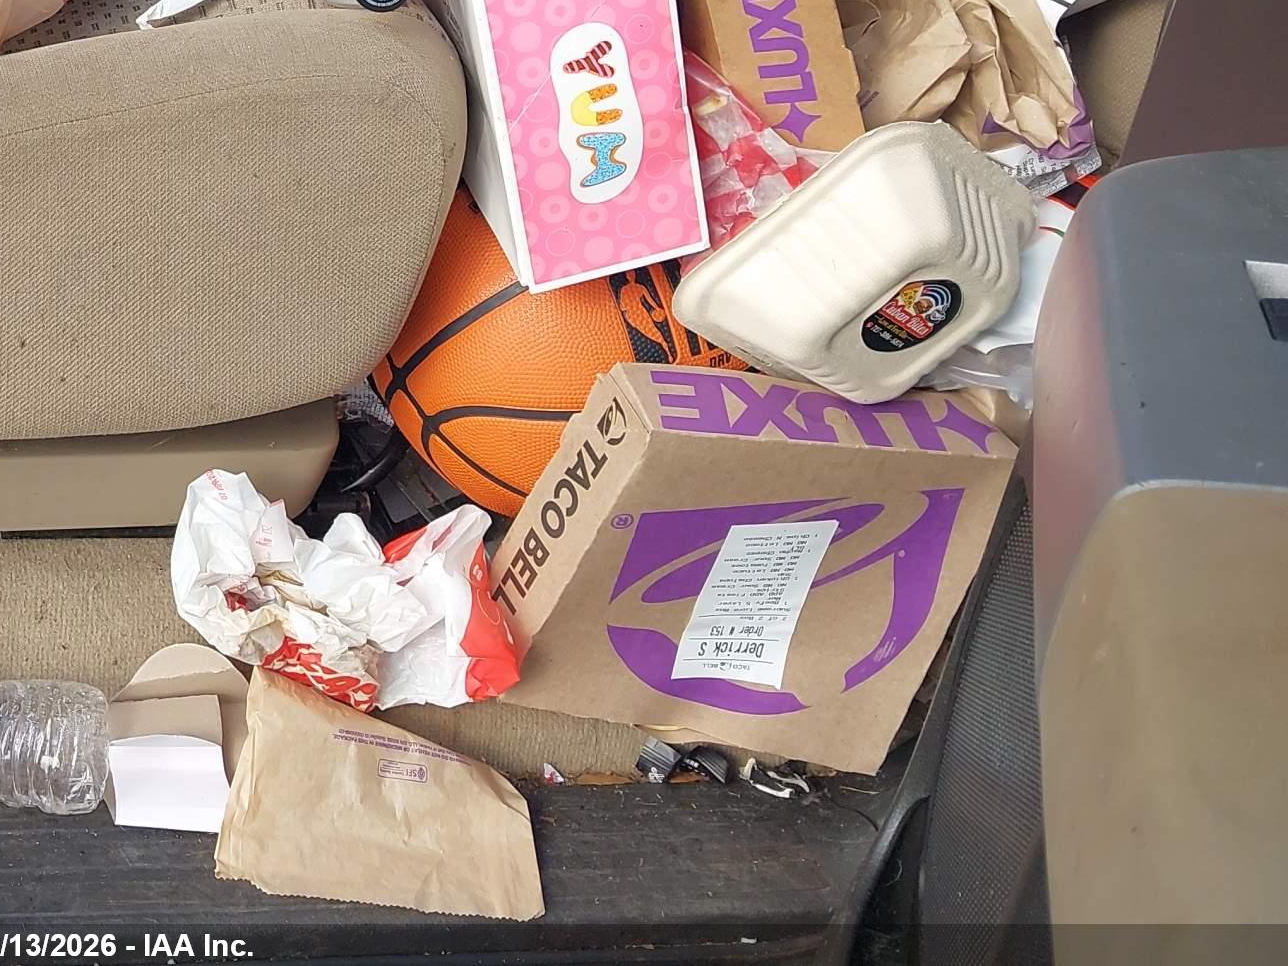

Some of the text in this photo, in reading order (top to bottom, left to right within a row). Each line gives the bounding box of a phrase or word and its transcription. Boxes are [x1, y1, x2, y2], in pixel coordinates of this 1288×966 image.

[562, 40, 627, 188] YUM
[490, 440, 608, 616] TACO BELL
[710, 625, 725, 636] 153
[738, 626, 764, 636] Order
[698, 641, 764, 658] Derrick S
